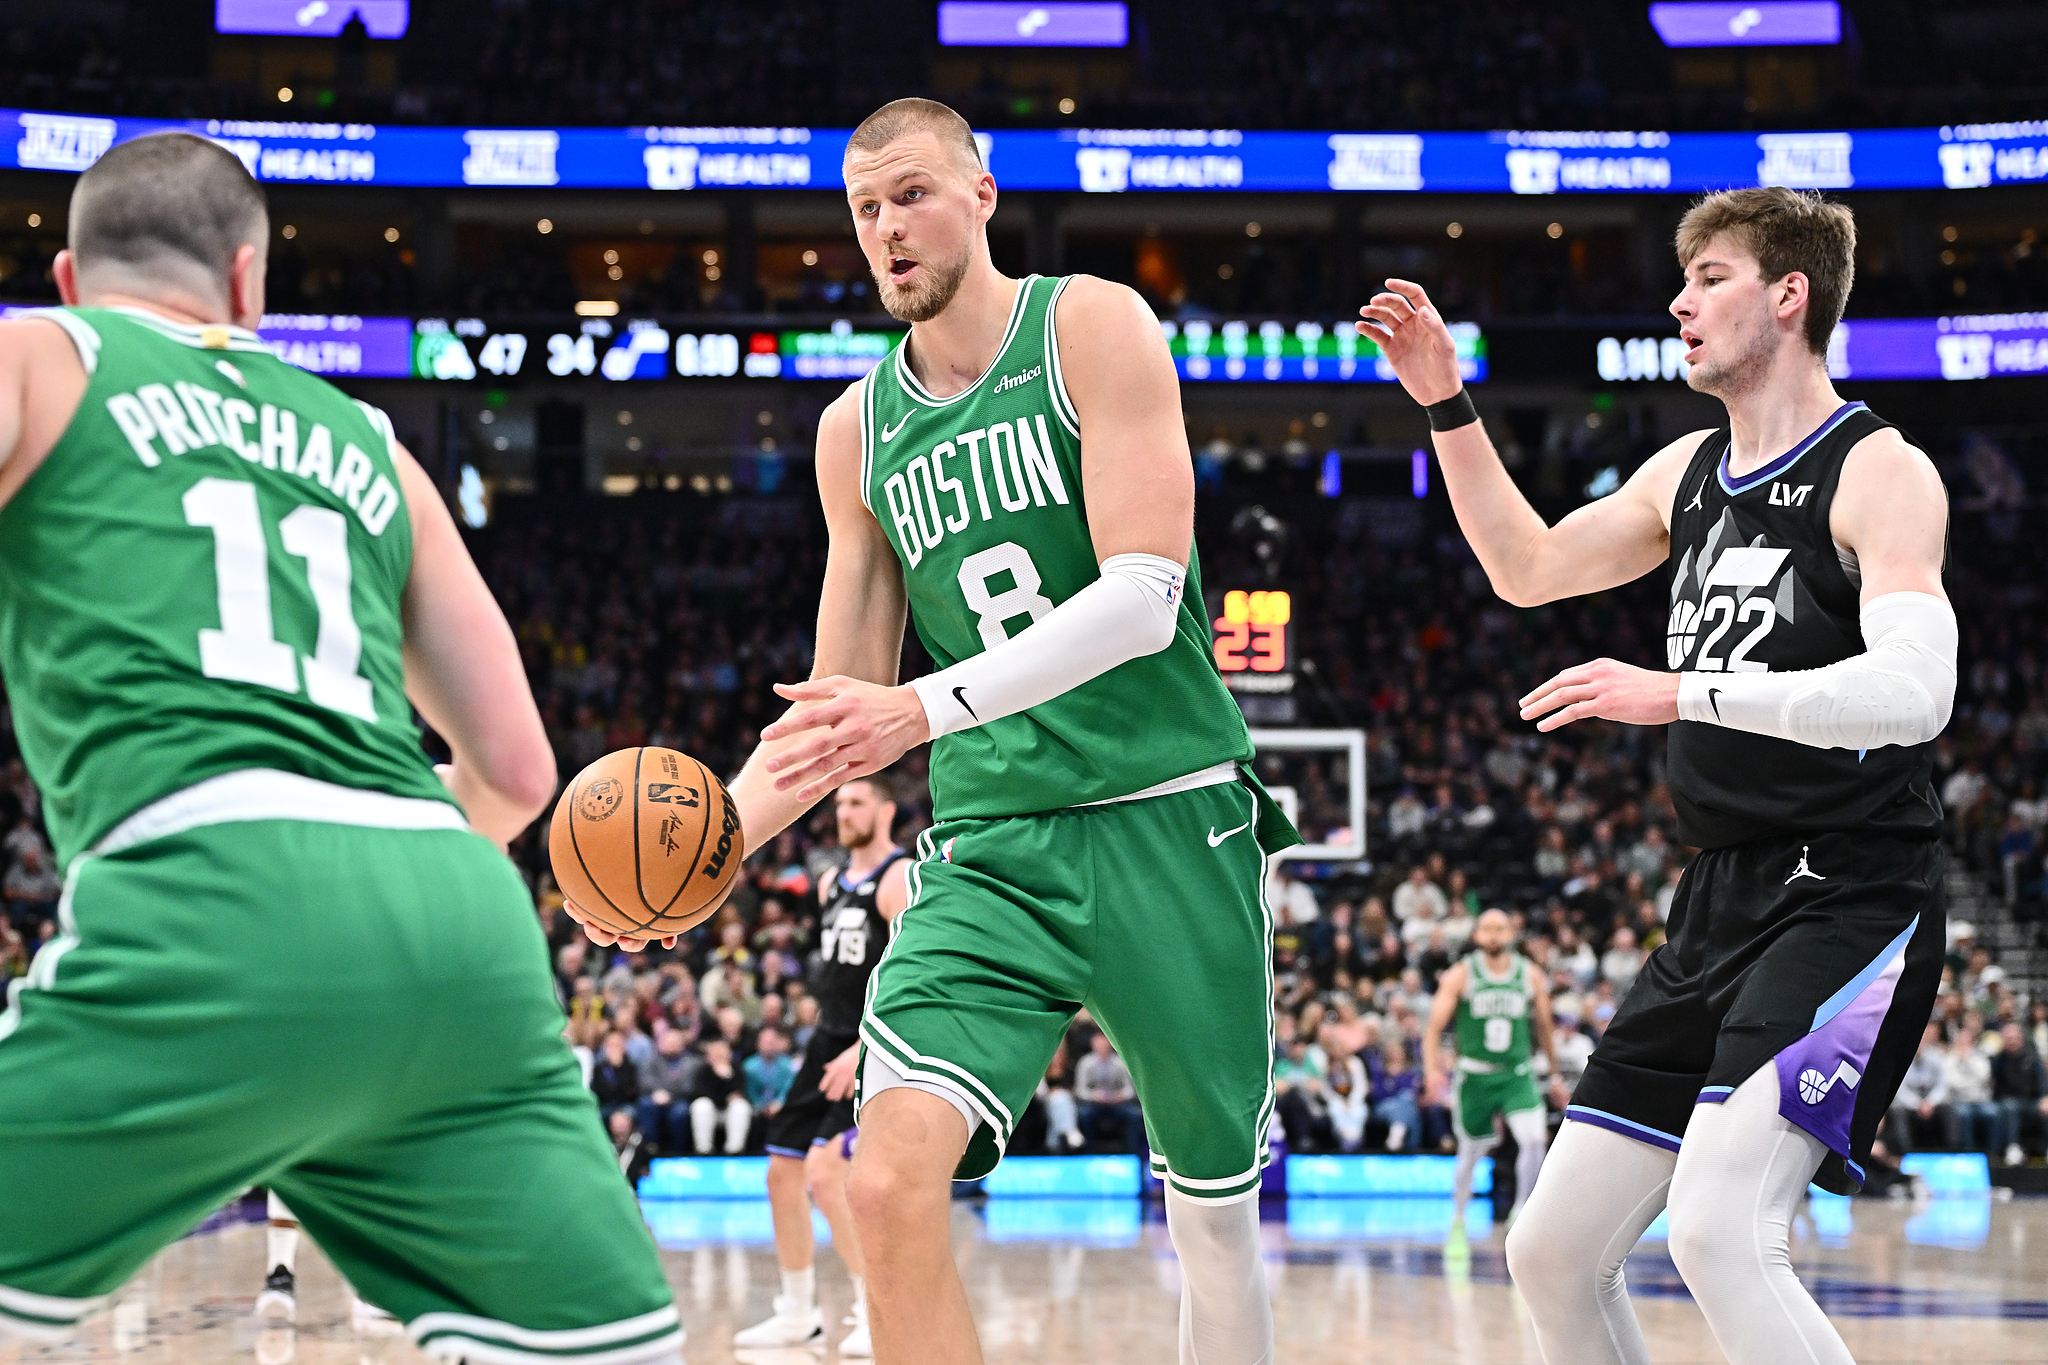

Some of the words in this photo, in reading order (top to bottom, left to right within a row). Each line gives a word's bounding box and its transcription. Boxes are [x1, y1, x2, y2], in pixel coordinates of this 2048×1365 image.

[479, 333, 527, 376] 47
[547, 333, 597, 376] 34
[993, 364, 1042, 395] Amica
[106, 381, 400, 537] PRITCHARD
[883, 414, 1070, 571] BOSTON
[1767, 482, 1815, 507] LVT
[181, 476, 379, 724] 11
[956, 541, 1056, 652] 8
[1213, 616, 1286, 672] 23
[1694, 595, 1776, 673] 22
